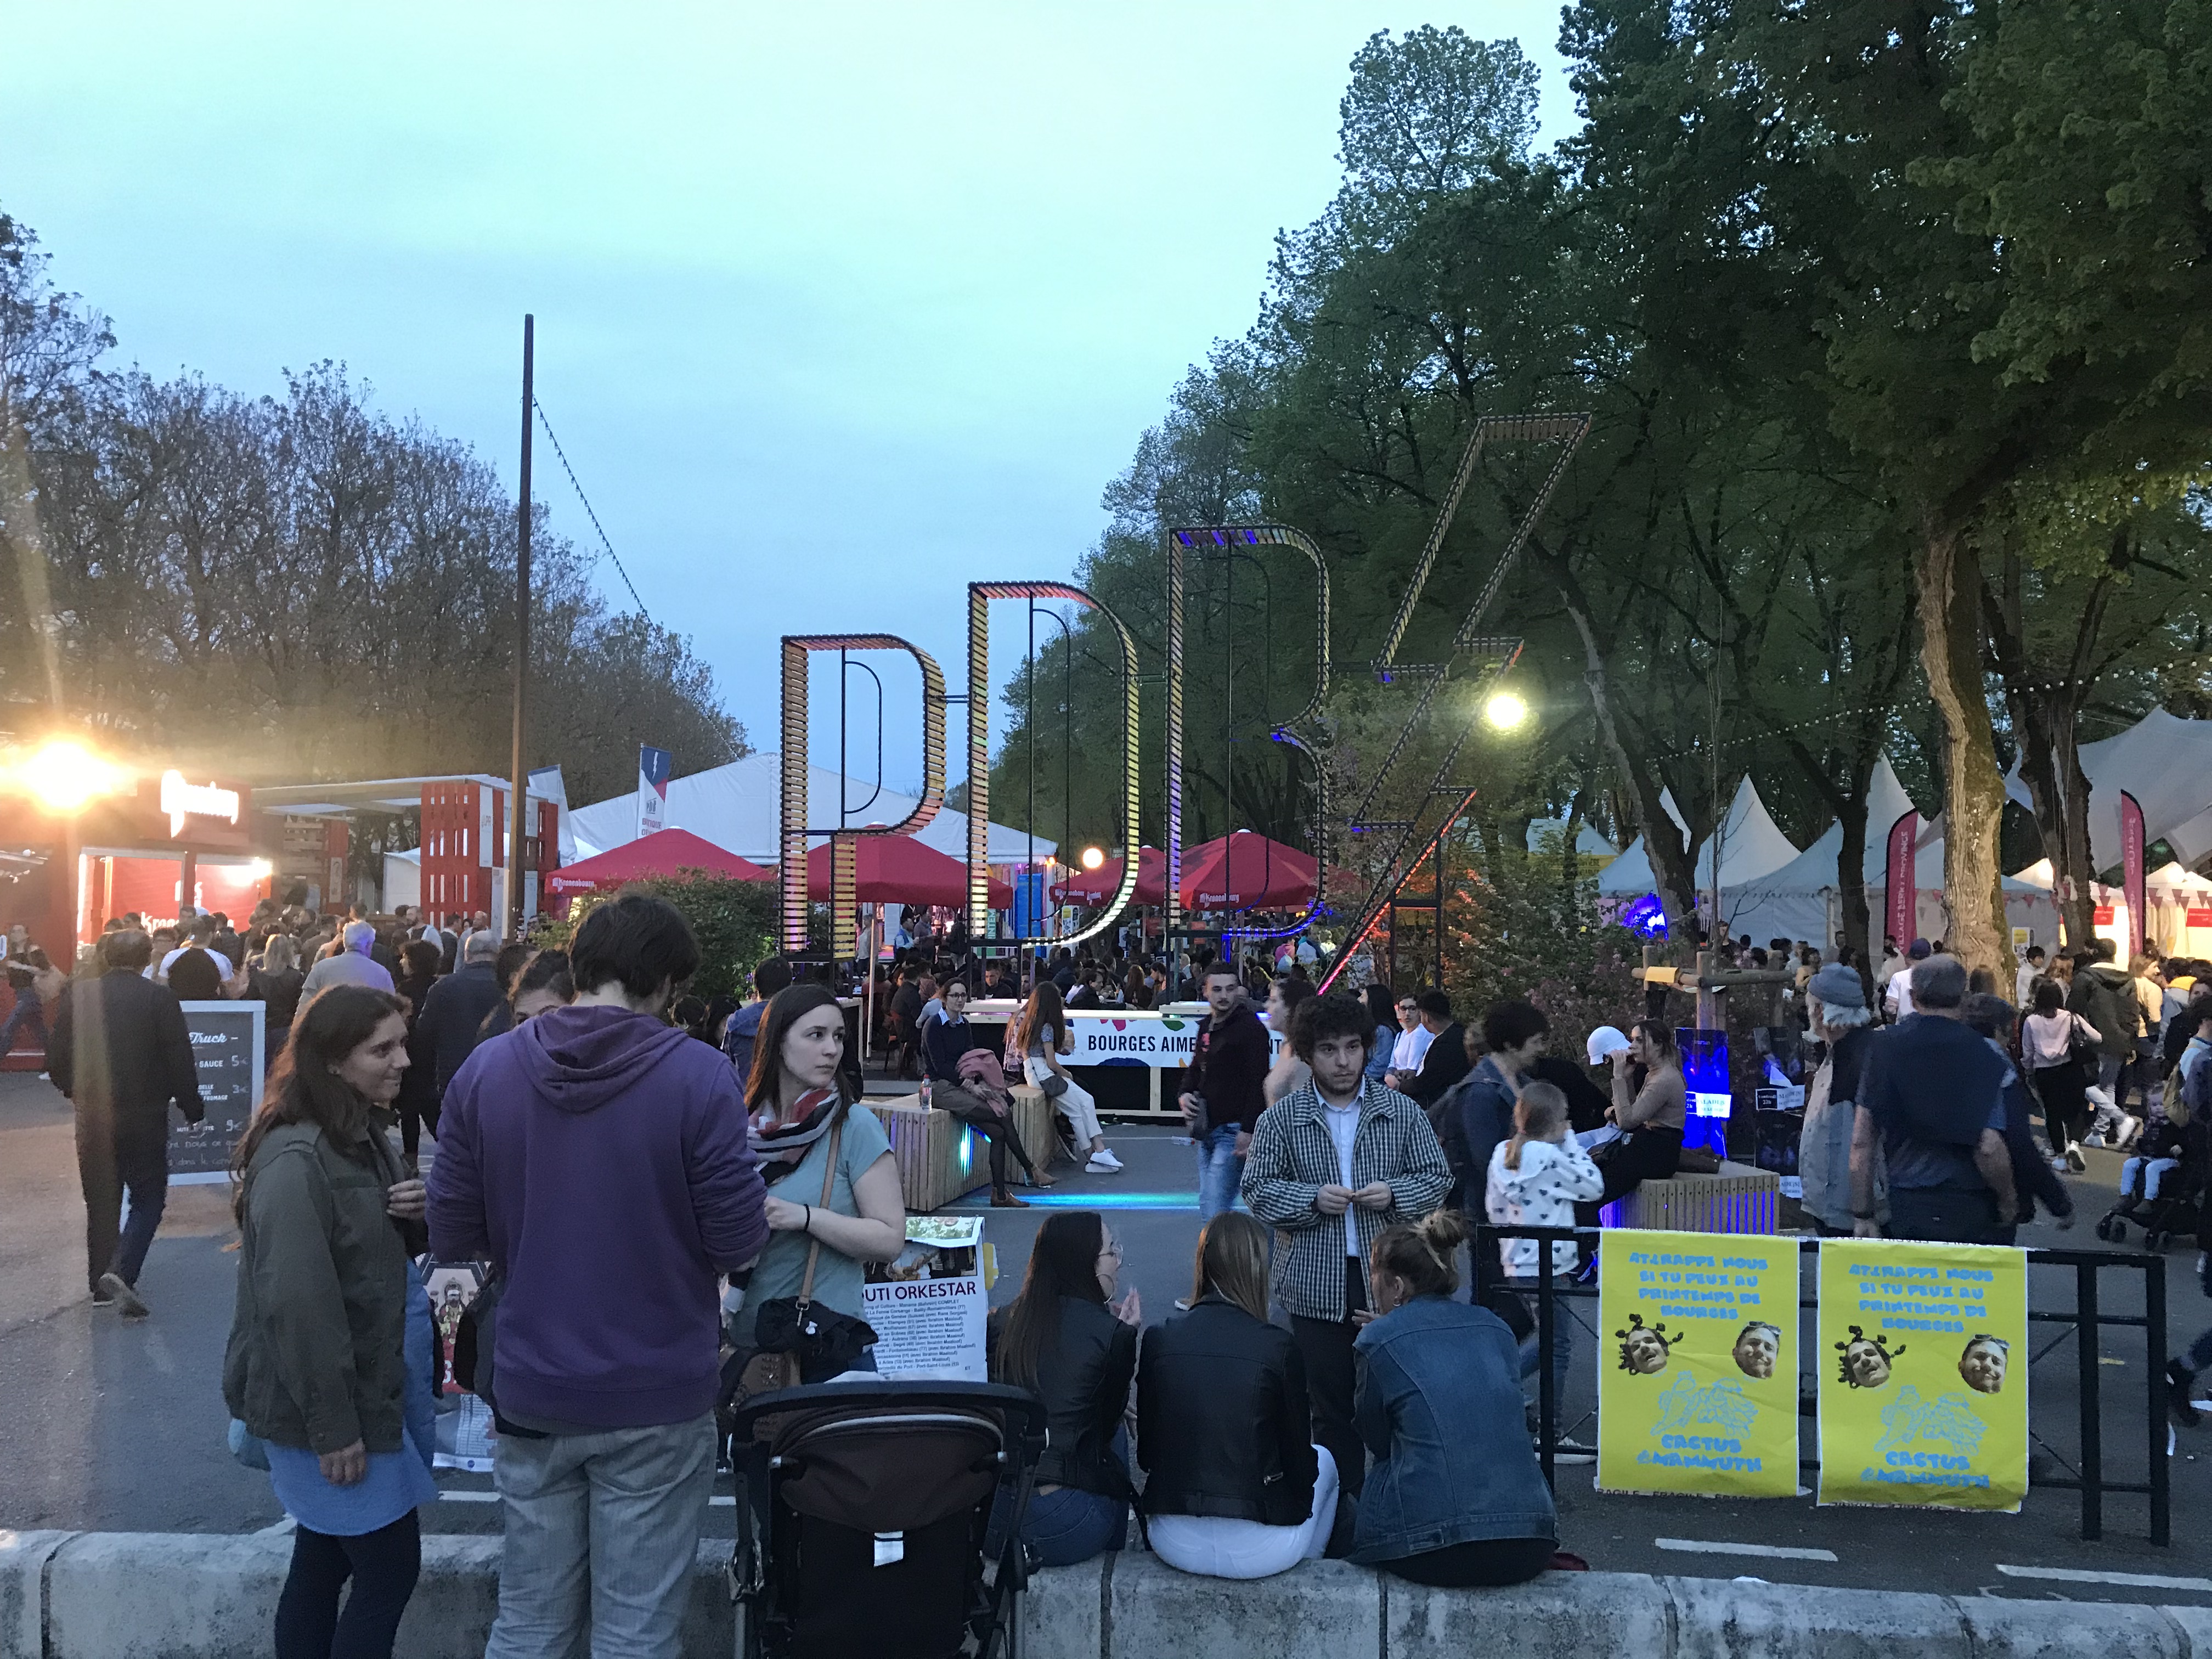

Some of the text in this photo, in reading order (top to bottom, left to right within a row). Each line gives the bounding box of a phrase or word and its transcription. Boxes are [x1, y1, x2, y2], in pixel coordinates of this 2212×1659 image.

[189, 1031, 227, 1044] Truck
[1088, 1035, 1155, 1052] BOURGES
[199, 1059, 223, 1068] SAUCE
[1722, 1257, 1768, 1270] NOUS
[1639, 1270, 1758, 1287] SI TU PEUX AU
[1946, 1268, 1994, 1282] NOUS
[895, 1281, 976, 1300] ORKESTAR
[1639, 1288, 1760, 1305] PRINTEMPS DE
[1859, 1282, 1876, 1294] SI
[1880, 1283, 1903, 1295] TU
[1959, 1286, 1984, 1299] AU
[1660, 1305, 1739, 1319] BOURGES
[1859, 1300, 1960, 1316] PRINTEMPS
[1661, 1434, 1742, 1453] CACTUS
[1886, 1451, 1970, 1470] CACTUS
